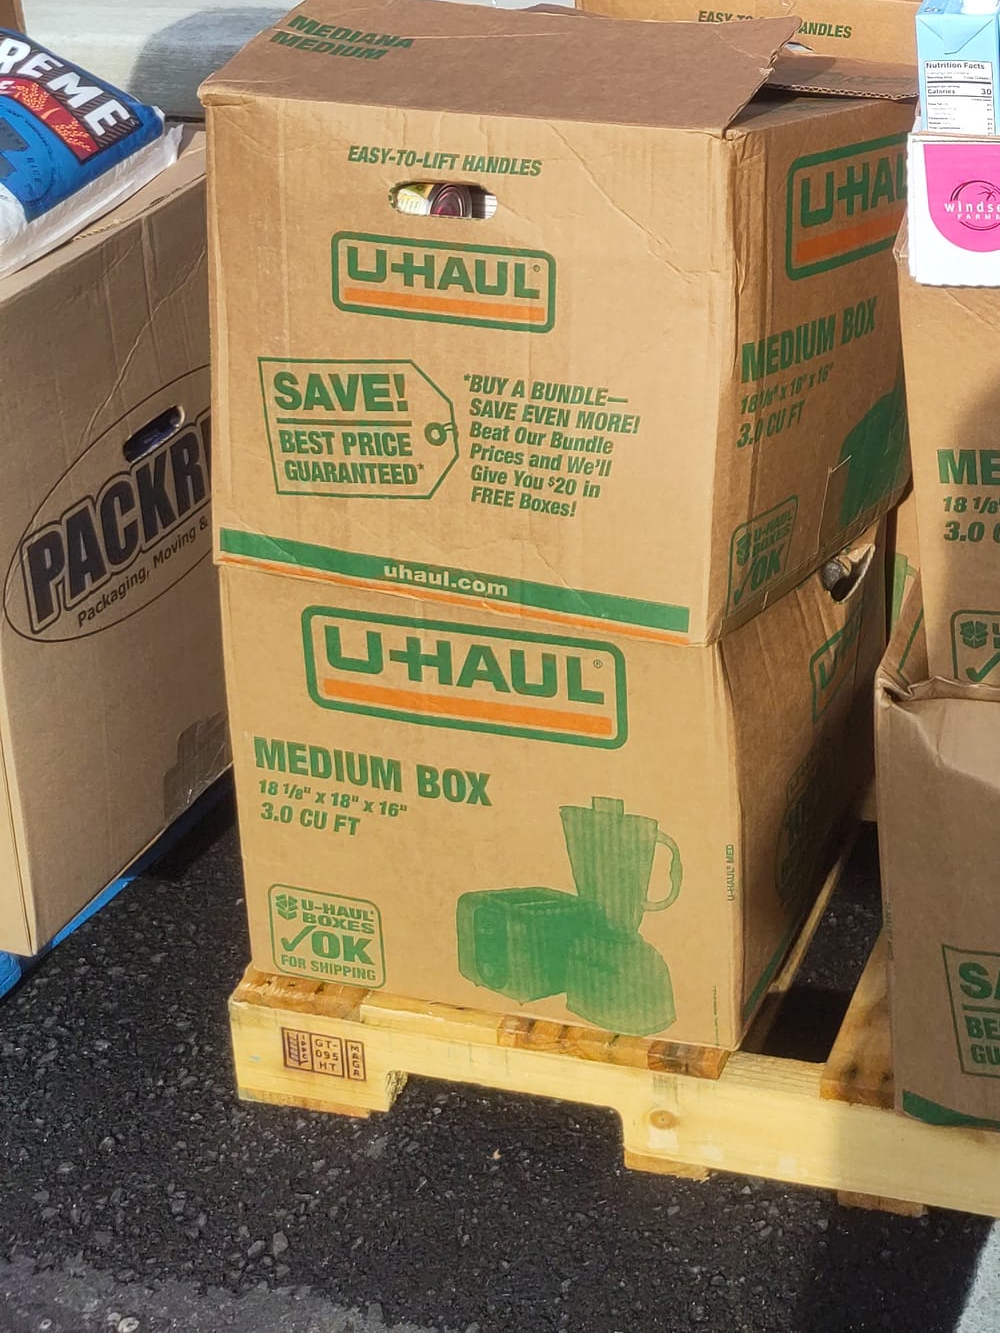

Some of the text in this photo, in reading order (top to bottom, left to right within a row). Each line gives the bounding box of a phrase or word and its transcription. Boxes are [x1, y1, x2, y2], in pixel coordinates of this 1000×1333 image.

[268, 30, 390, 60] MEDIUM
[286, 14, 416, 49] MEDIANA
[798, 21, 853, 39] ANDLES
[926, 62, 985, 70] Nutrition Facts
[980, 88, 992, 96] 30
[347, 145, 542, 177] EASY-TO-LIFT HANDLES
[800, 153, 908, 228] U-HA
[740, 296, 878, 384] MEDIUM BOX
[273, 371, 409, 412] SAVE!
[510, 379, 526, 398] A
[468, 398, 642, 434] SAVE EVEN MORE!
[766, 410, 784, 440] CU
[787, 399, 806, 431] FT
[278, 429, 413, 457] BEST PRICE
[469, 421, 614, 455] Beat Our Bundle
[469, 442, 612, 477] Prices and We'll
[470, 464, 602, 498] Give You $20 in
[470, 486, 578, 518] FREE Boxes!
[942, 496, 968, 514] 18
[943, 520, 985, 543] 3.0
[78, 567, 150, 628] Packaging,
[153, 525, 196, 570] Moving
[383, 564, 509, 598] uhaul.com
[751, 544, 784, 591] OK
[253, 736, 493, 807] MEDIUM BOX
[258, 778, 278, 796] 18
[314, 791, 326, 804] x
[330, 792, 360, 809] 18"
[362, 800, 375, 813] x
[378, 800, 408, 818] 16"
[260, 802, 361, 836] 3.0 CU FT
[725, 844, 734, 864] MED
[301, 898, 375, 922] U-HAUL
[302, 912, 375, 934] BOXES
[311, 930, 376, 966] OK
[280, 954, 377, 981] FOR SHIPPING
[319, 1062, 337, 1072] HT
